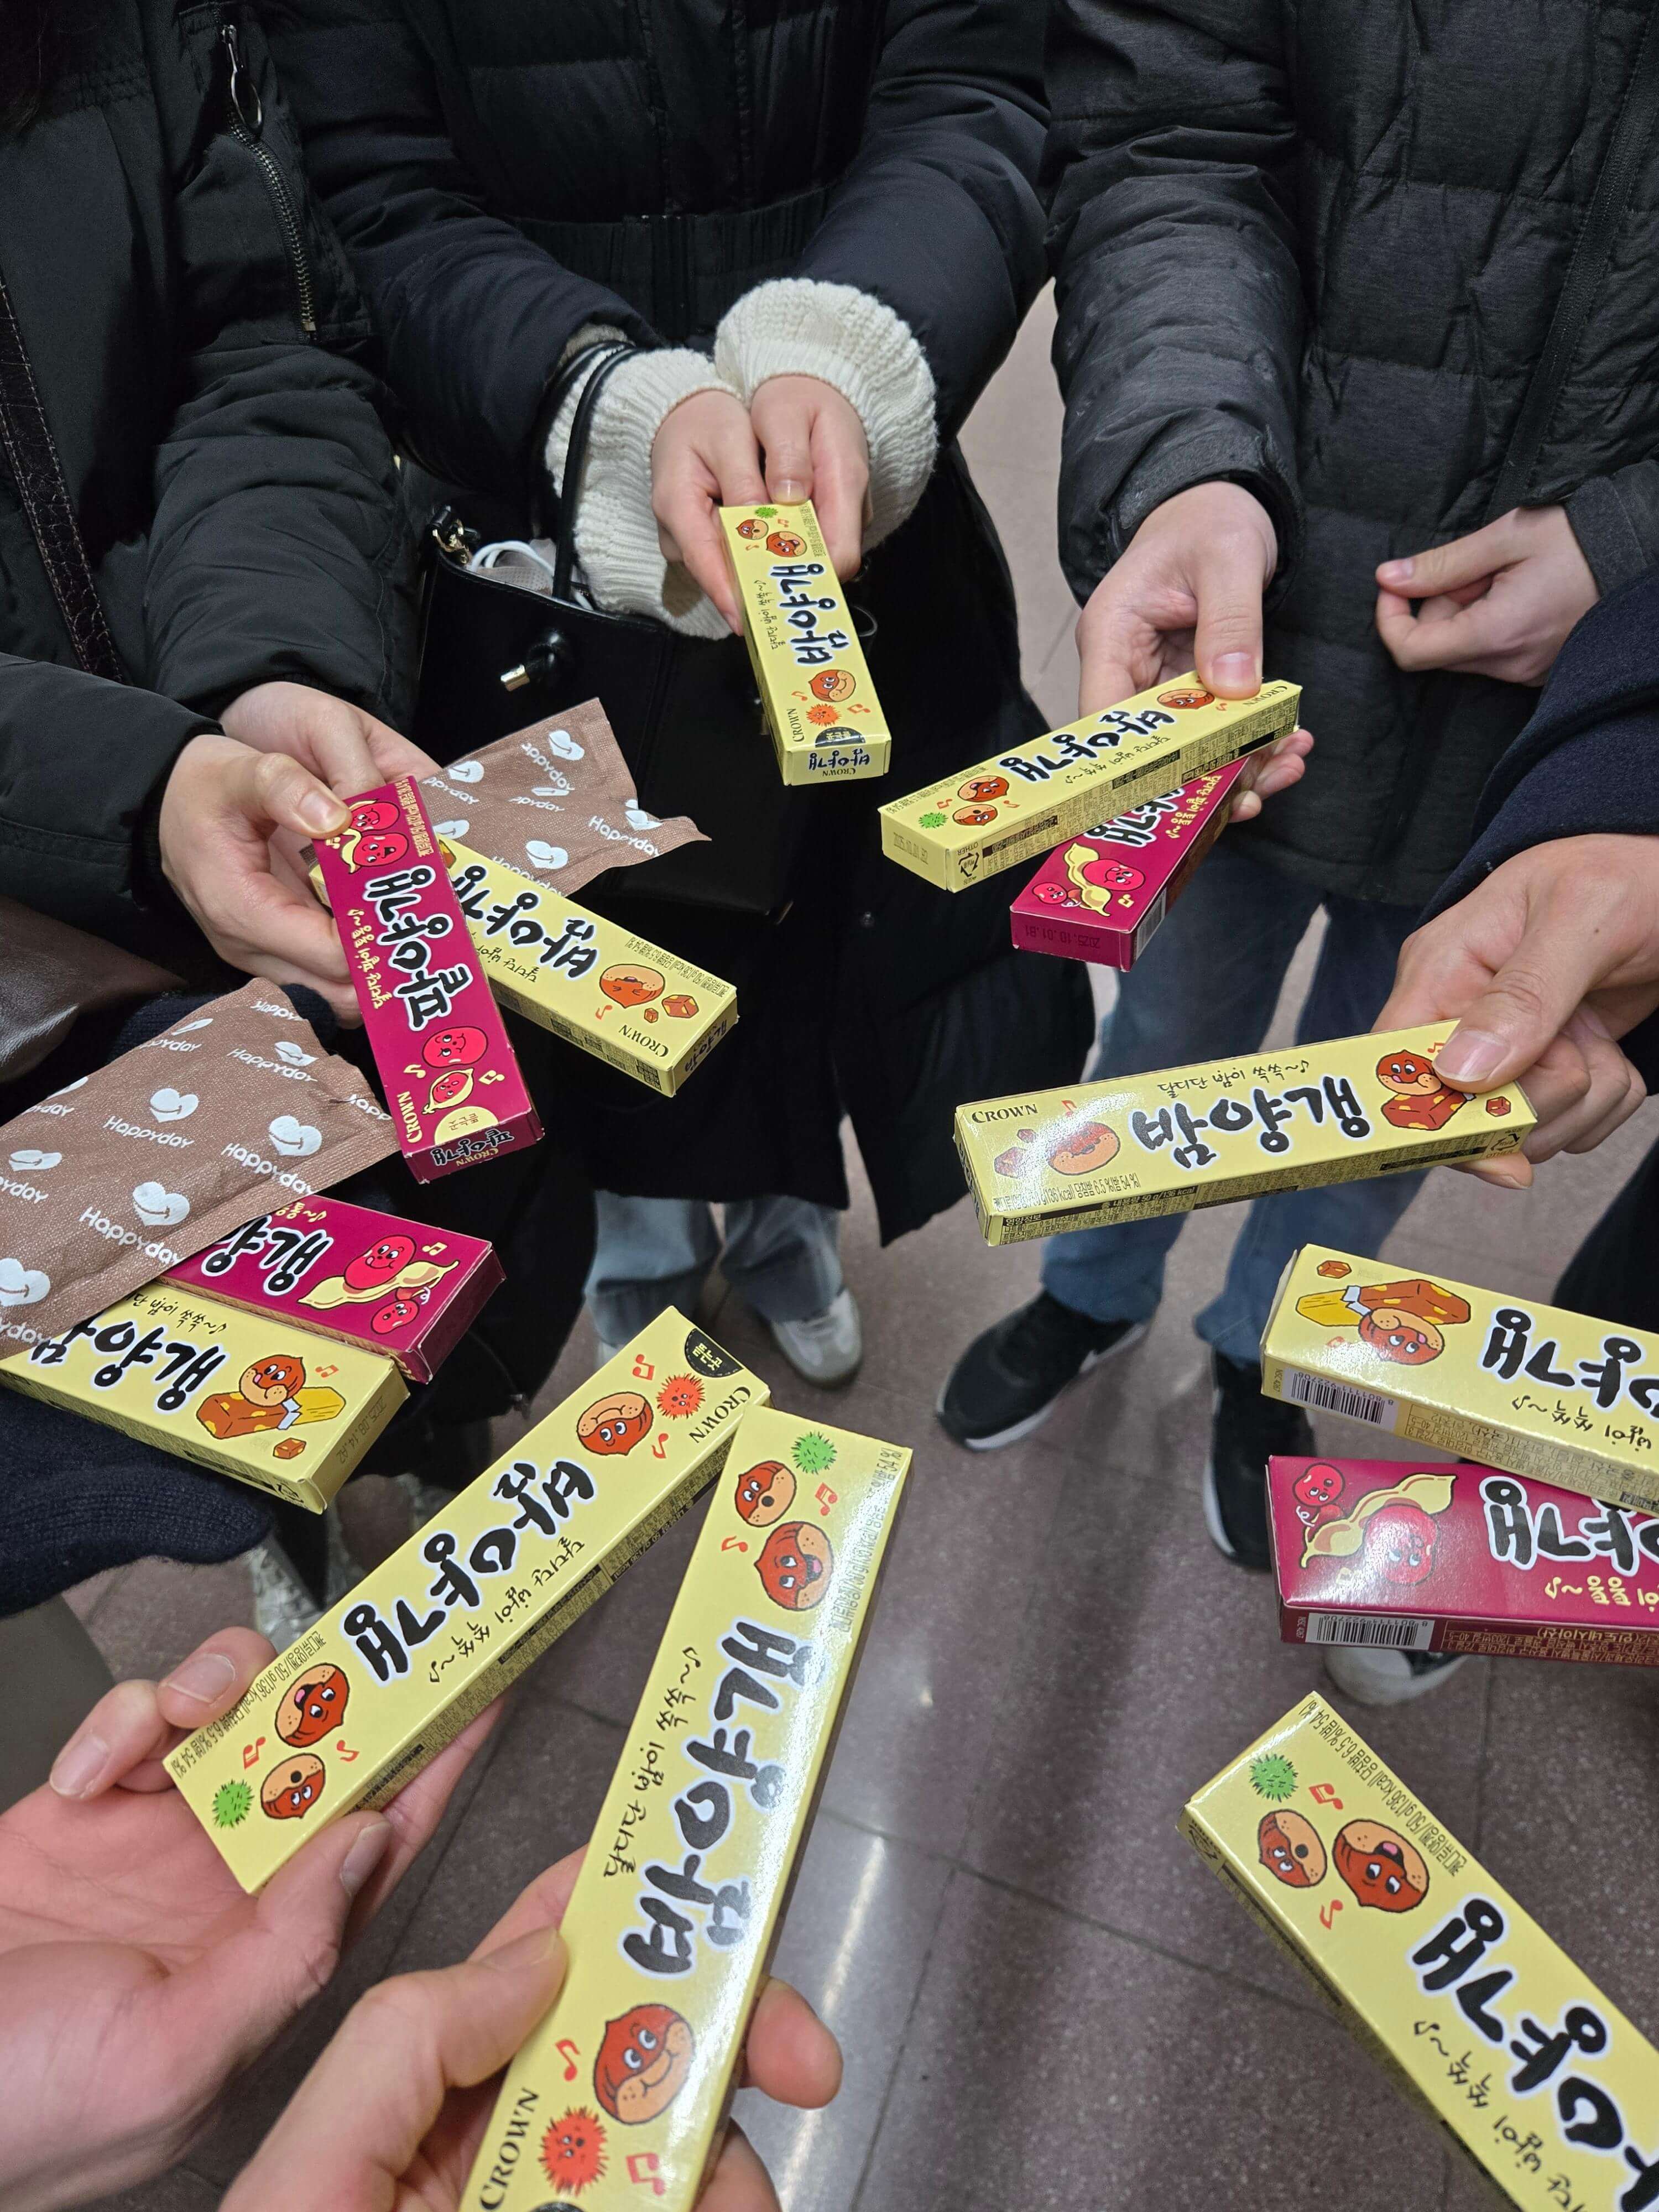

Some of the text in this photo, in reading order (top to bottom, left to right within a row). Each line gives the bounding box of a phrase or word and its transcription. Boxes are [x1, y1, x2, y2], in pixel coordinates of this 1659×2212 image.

[770, 563, 849, 665] 밤양갱
[1243, 685, 1288, 707] CROWN
[791, 708, 805, 742] CROWN
[808, 749, 870, 770] 밤양갱
[1000, 709, 1175, 782] 밤양갱
[822, 766, 856, 777] CROWN
[588, 815, 661, 857] Happyday
[368, 867, 469, 1028] 팥양갱
[251, 1000, 304, 1021] Happy
[618, 1023, 669, 1058] CROWN
[226, 1048, 318, 1082] Happyday
[1157, 1072, 1208, 1097] 달디단
[1211, 1067, 1246, 1086] 밤이
[397, 1092, 423, 1143] CROWN
[971, 1103, 1039, 1123] CROWN
[1133, 1077, 1371, 1169] 밤양갱
[103, 1115, 195, 1149] Happyday
[432, 1129, 514, 1165] 팥양갱
[221, 1142, 317, 1196] Happyday
[456, 1147, 499, 1166] CROWN
[79, 1206, 185, 1265] Happyday
[1005, 1212, 1041, 1227] 영양정보
[148, 1297, 178, 1316] 밤이
[692, 1341, 724, 1373] 뜯는곳
[688, 1385, 752, 1443] CROWN
[344, 1460, 594, 1681] 밤양갱
[531, 1536, 585, 1588] 달디단
[494, 1585, 532, 1624] 밤이
[1310, 1709, 1331, 1730] 54
[1334, 1735, 1359, 1759] 6.5
[1345, 1747, 1380, 1781] 당침밤
[604, 1803, 648, 1878] 달디단
[630, 1740, 666, 1792] 밤이
[623, 1621, 821, 1974] 밤양갱
[478, 2088, 540, 2212] CROWN
[1493, 2115, 1543, 2173] 밤이
